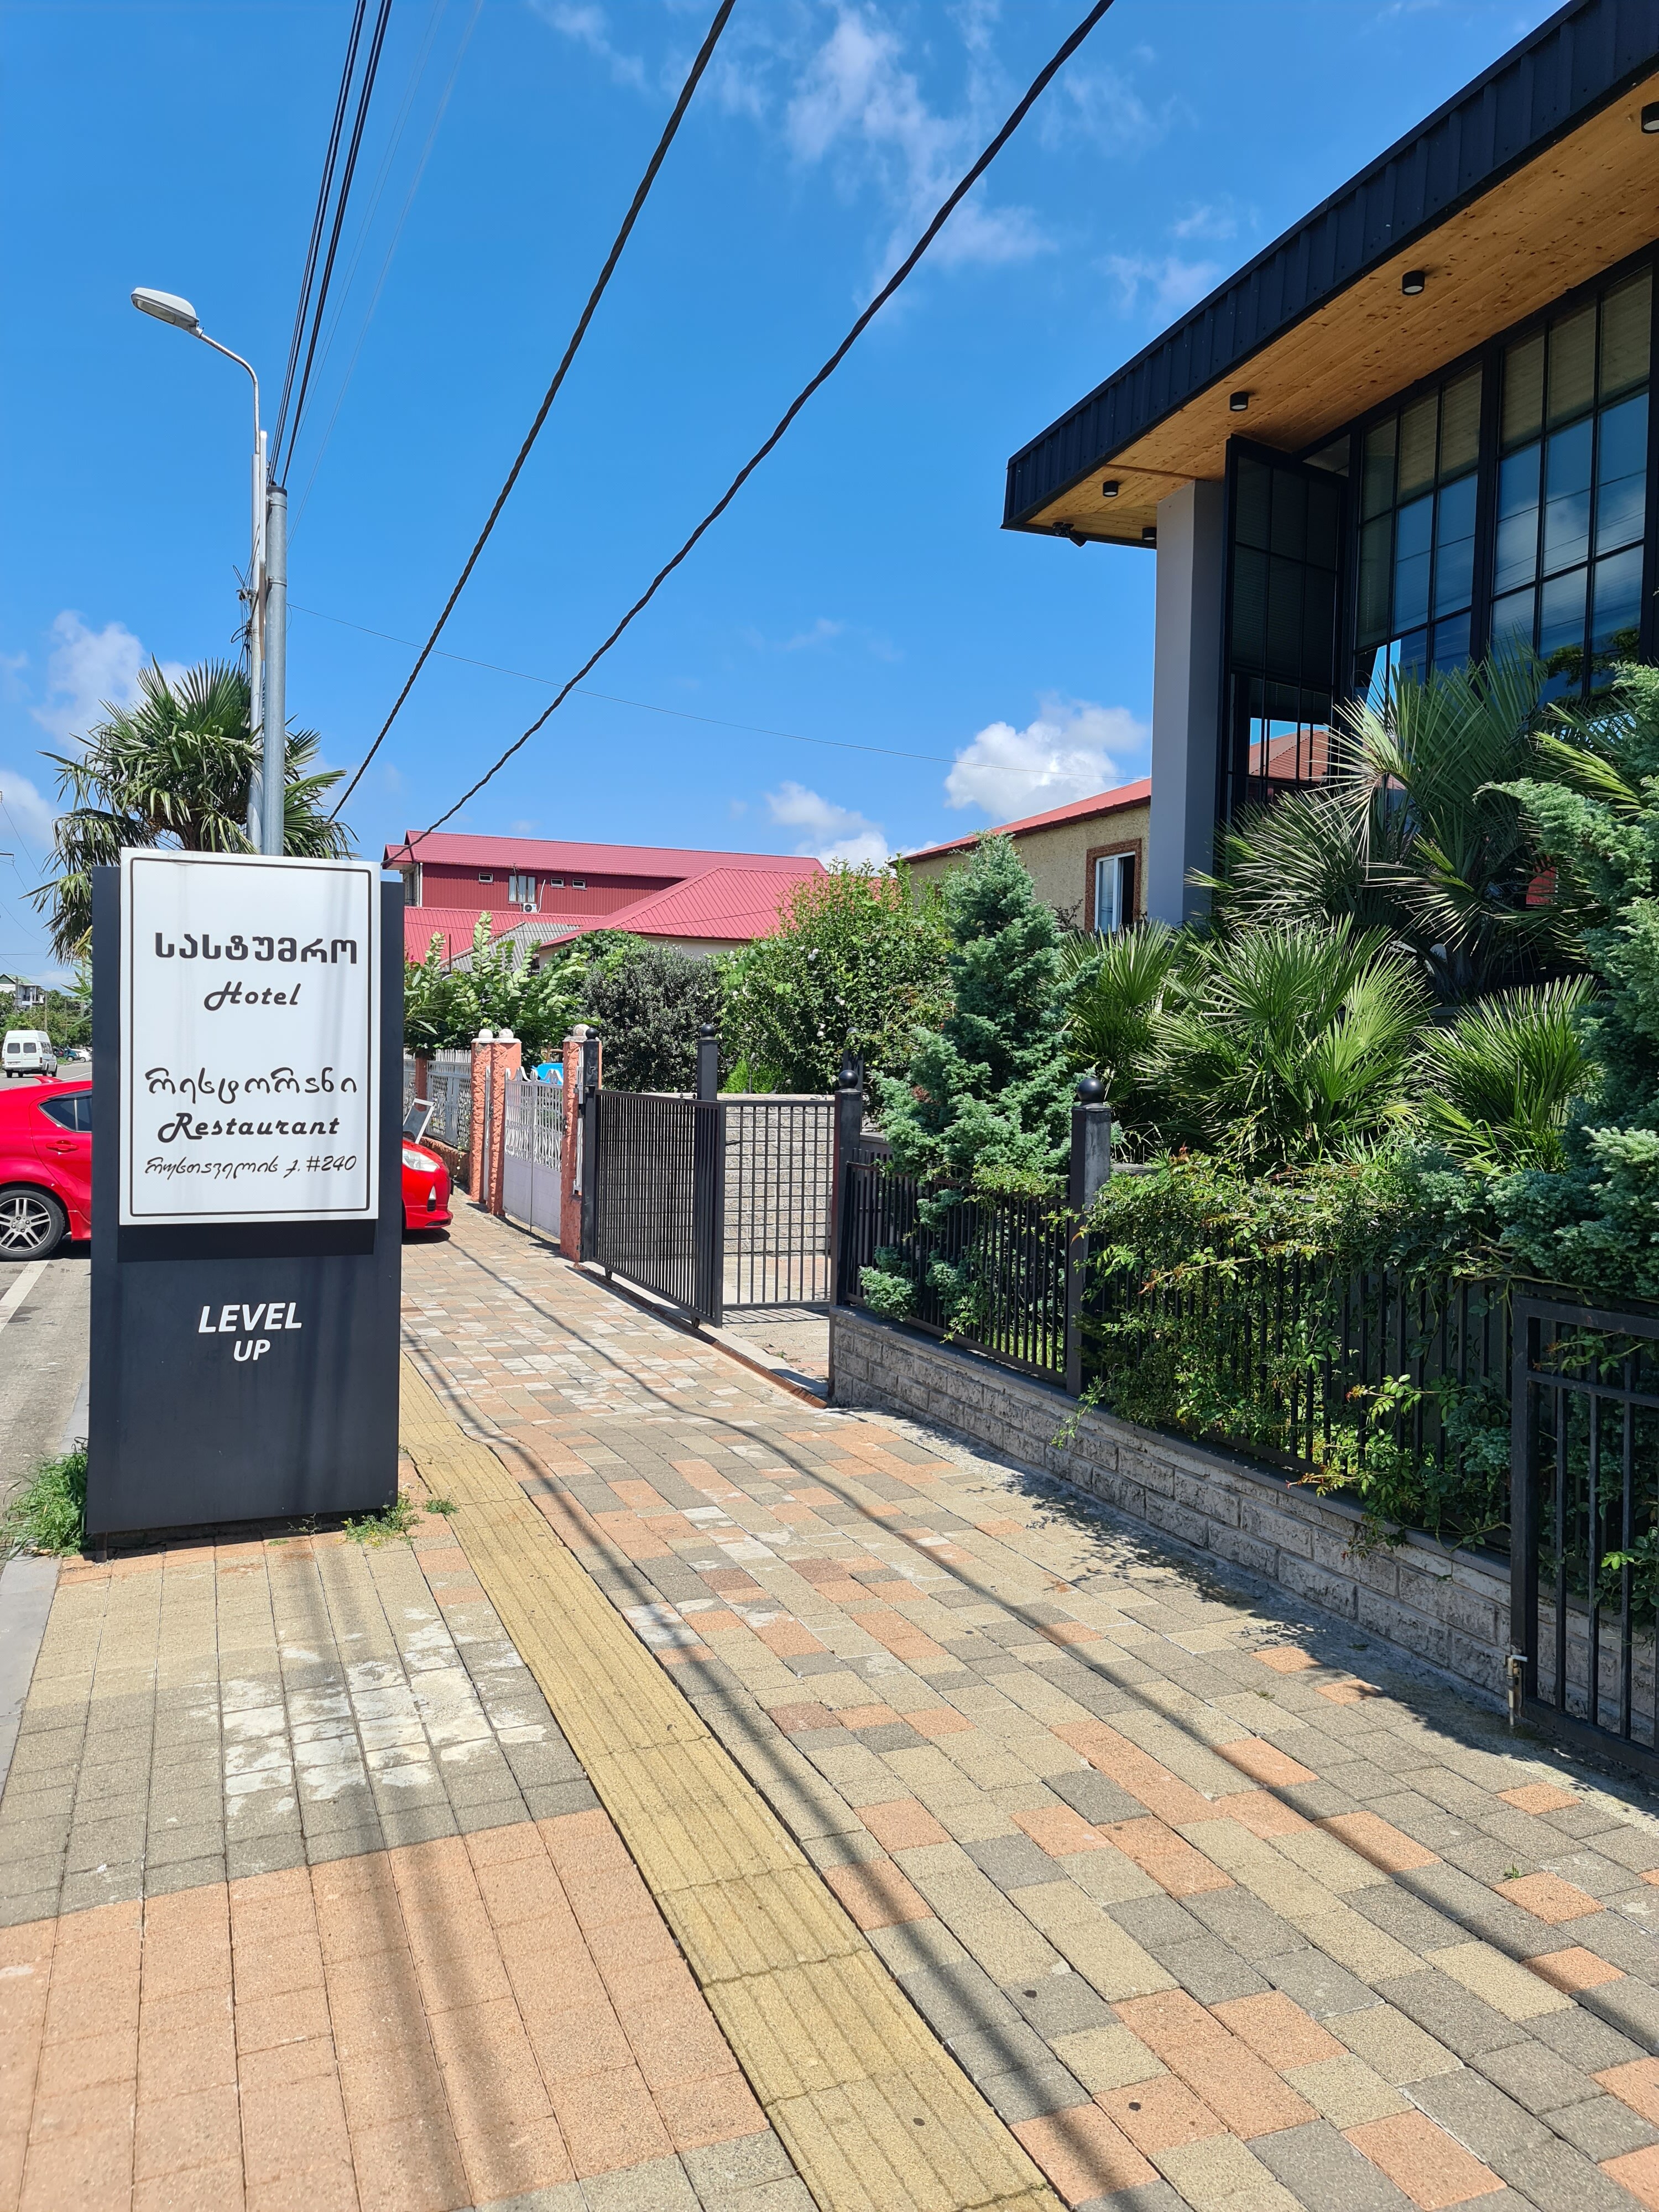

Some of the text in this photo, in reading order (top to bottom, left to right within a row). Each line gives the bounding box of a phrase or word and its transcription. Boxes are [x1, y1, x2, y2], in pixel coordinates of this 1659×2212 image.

[155, 932, 357, 964] სასტუმრო
[204, 981, 301, 1011] Hotel
[145, 1067, 357, 1104] რესტორანი
[158, 1113, 340, 1143] Restaurant
[144, 1155, 279, 1180] რუსთაველის
[306, 1155, 357, 1172] #240
[198, 1302, 302, 1333] LEVEL
[233, 1339, 270, 1361] UP
